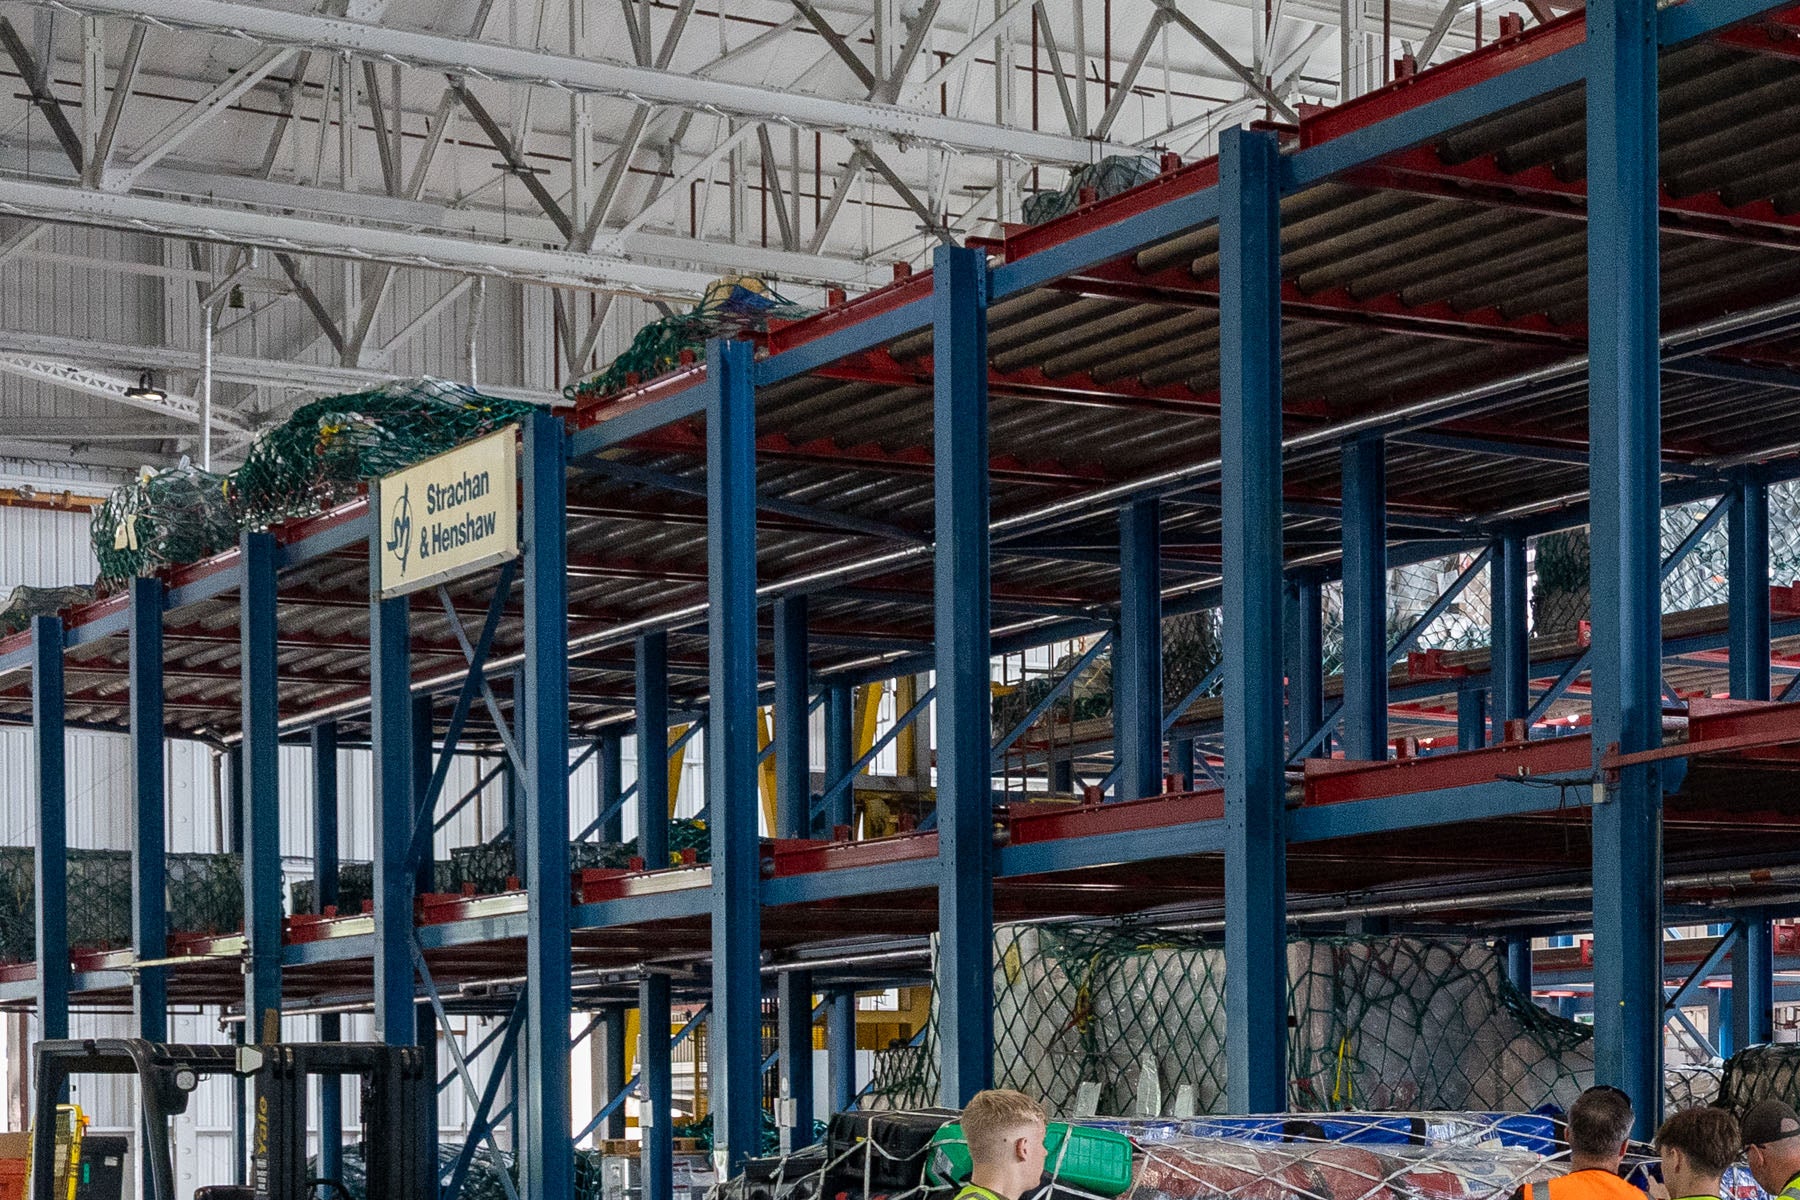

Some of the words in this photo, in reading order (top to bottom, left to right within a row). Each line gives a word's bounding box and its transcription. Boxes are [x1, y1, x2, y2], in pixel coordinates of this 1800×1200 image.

[426, 471, 490, 516] Strachan
[419, 526, 430, 559] &
[431, 511, 497, 555] Henshaw
